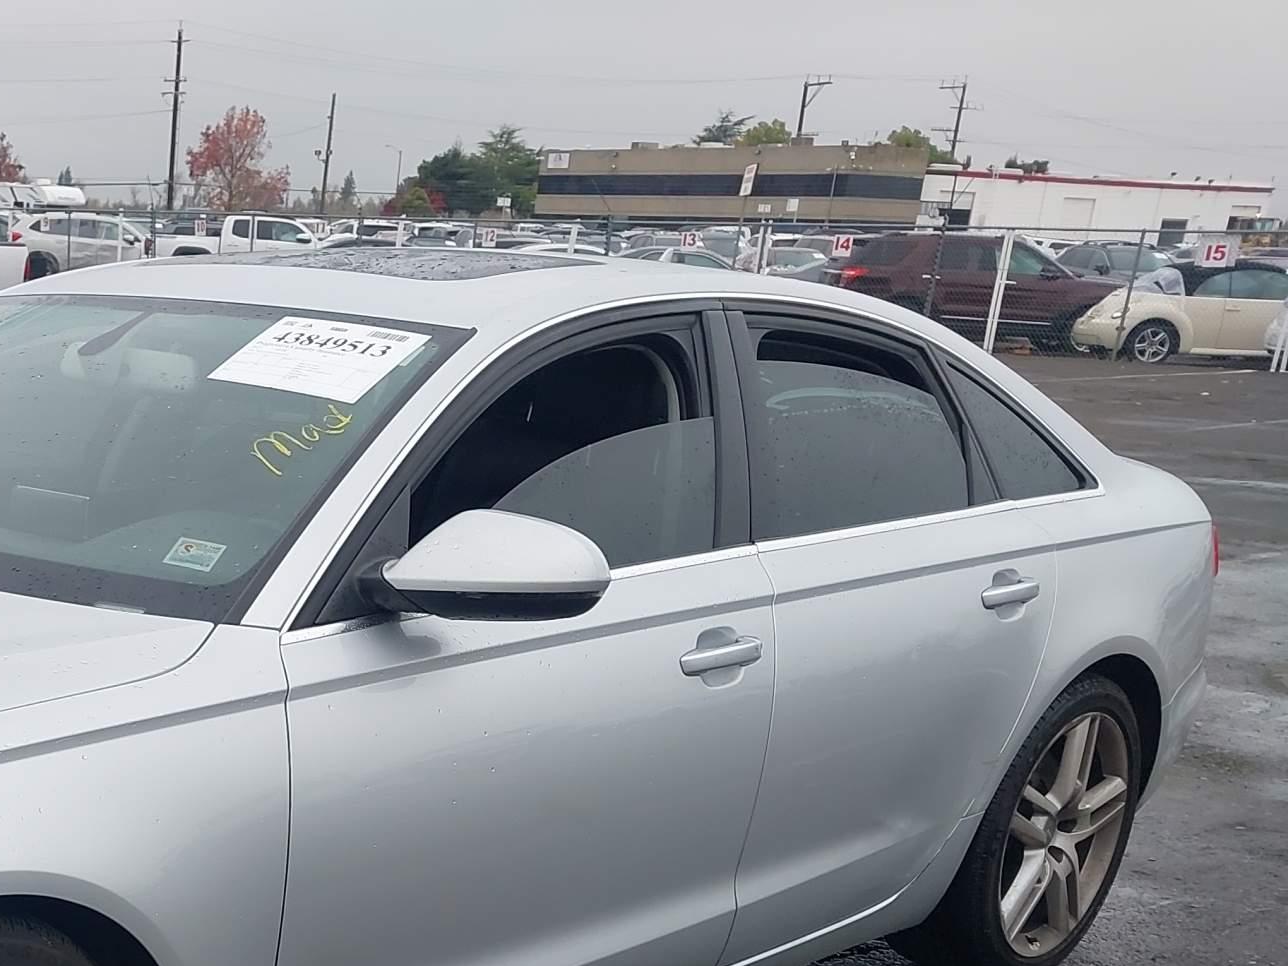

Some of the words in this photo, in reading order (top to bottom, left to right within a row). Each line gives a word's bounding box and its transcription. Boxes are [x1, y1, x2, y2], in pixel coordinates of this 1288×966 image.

[485, 229, 496, 242] 12
[682, 232, 697, 247] 13
[834, 235, 851, 251] 14
[1204, 244, 1227, 262] 15
[272, 331, 392, 357] 43849513
